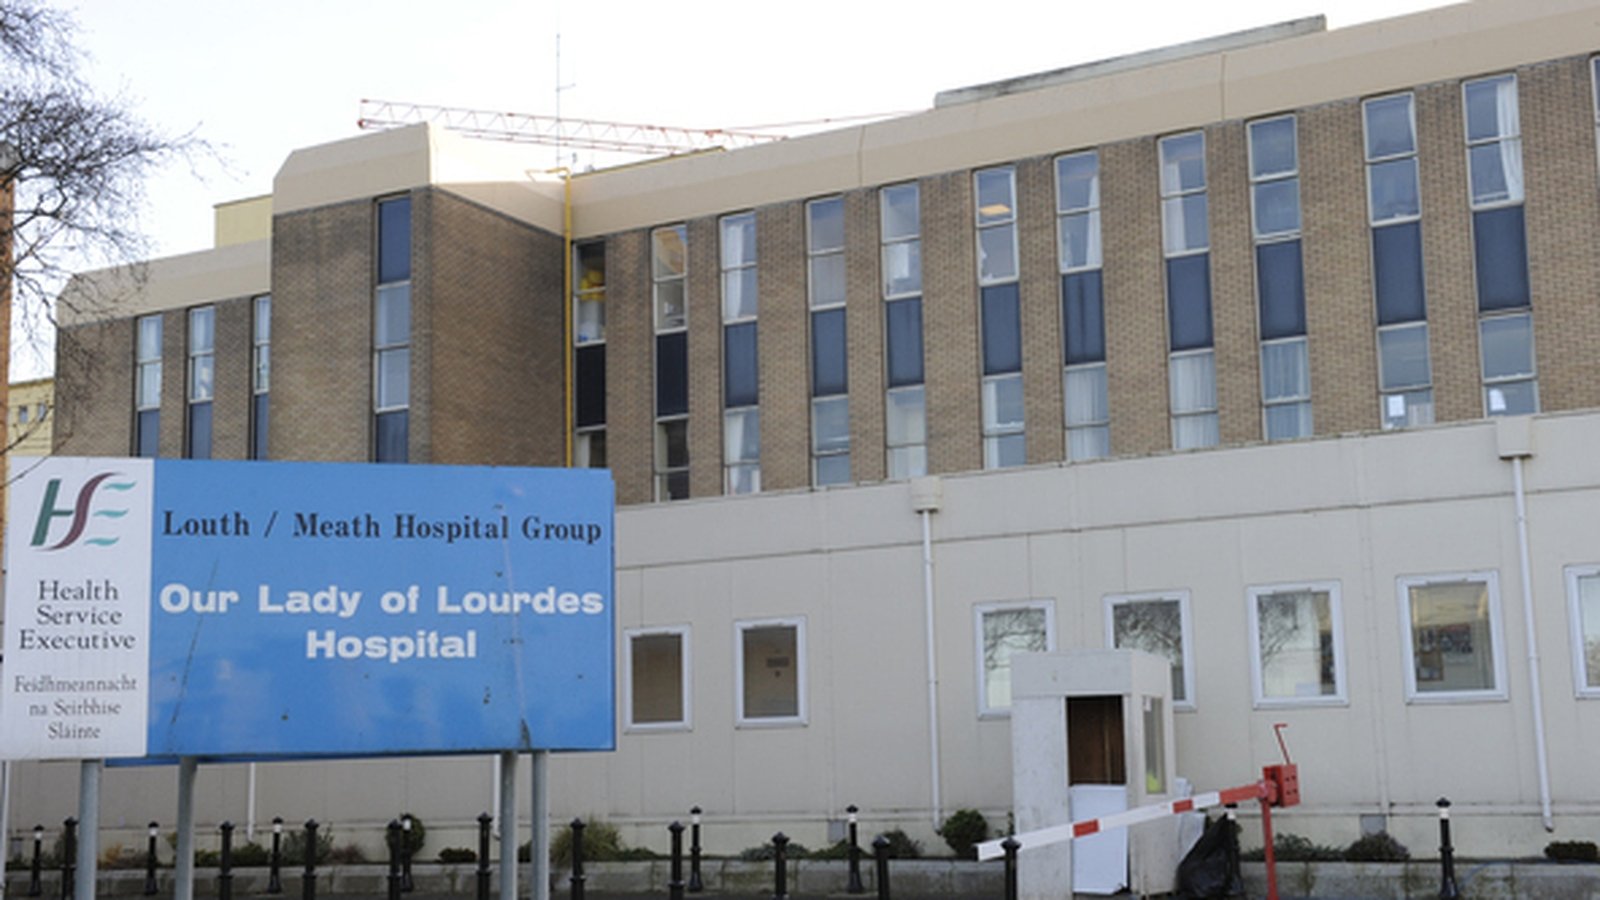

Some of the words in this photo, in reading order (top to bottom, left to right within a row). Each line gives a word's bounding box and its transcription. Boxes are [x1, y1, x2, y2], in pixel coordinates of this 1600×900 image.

[30, 472, 137, 551] HSE
[162, 511, 250, 537] Louth
[264, 511, 278, 538] /
[293, 513, 381, 539] Meath
[394, 514, 509, 544] Hospital
[521, 516, 603, 545] Group
[38, 580, 119, 601] Health
[159, 584, 240, 614] Our
[258, 585, 362, 618] Lady
[380, 585, 420, 614] of
[437, 585, 605, 615] Lourdes
[36, 604, 122, 625] Service
[19, 629, 136, 650] Executive
[306, 630, 477, 663] Hospital
[14, 675, 137, 693] Feidhmeannacht
[29, 704, 48, 717] na
